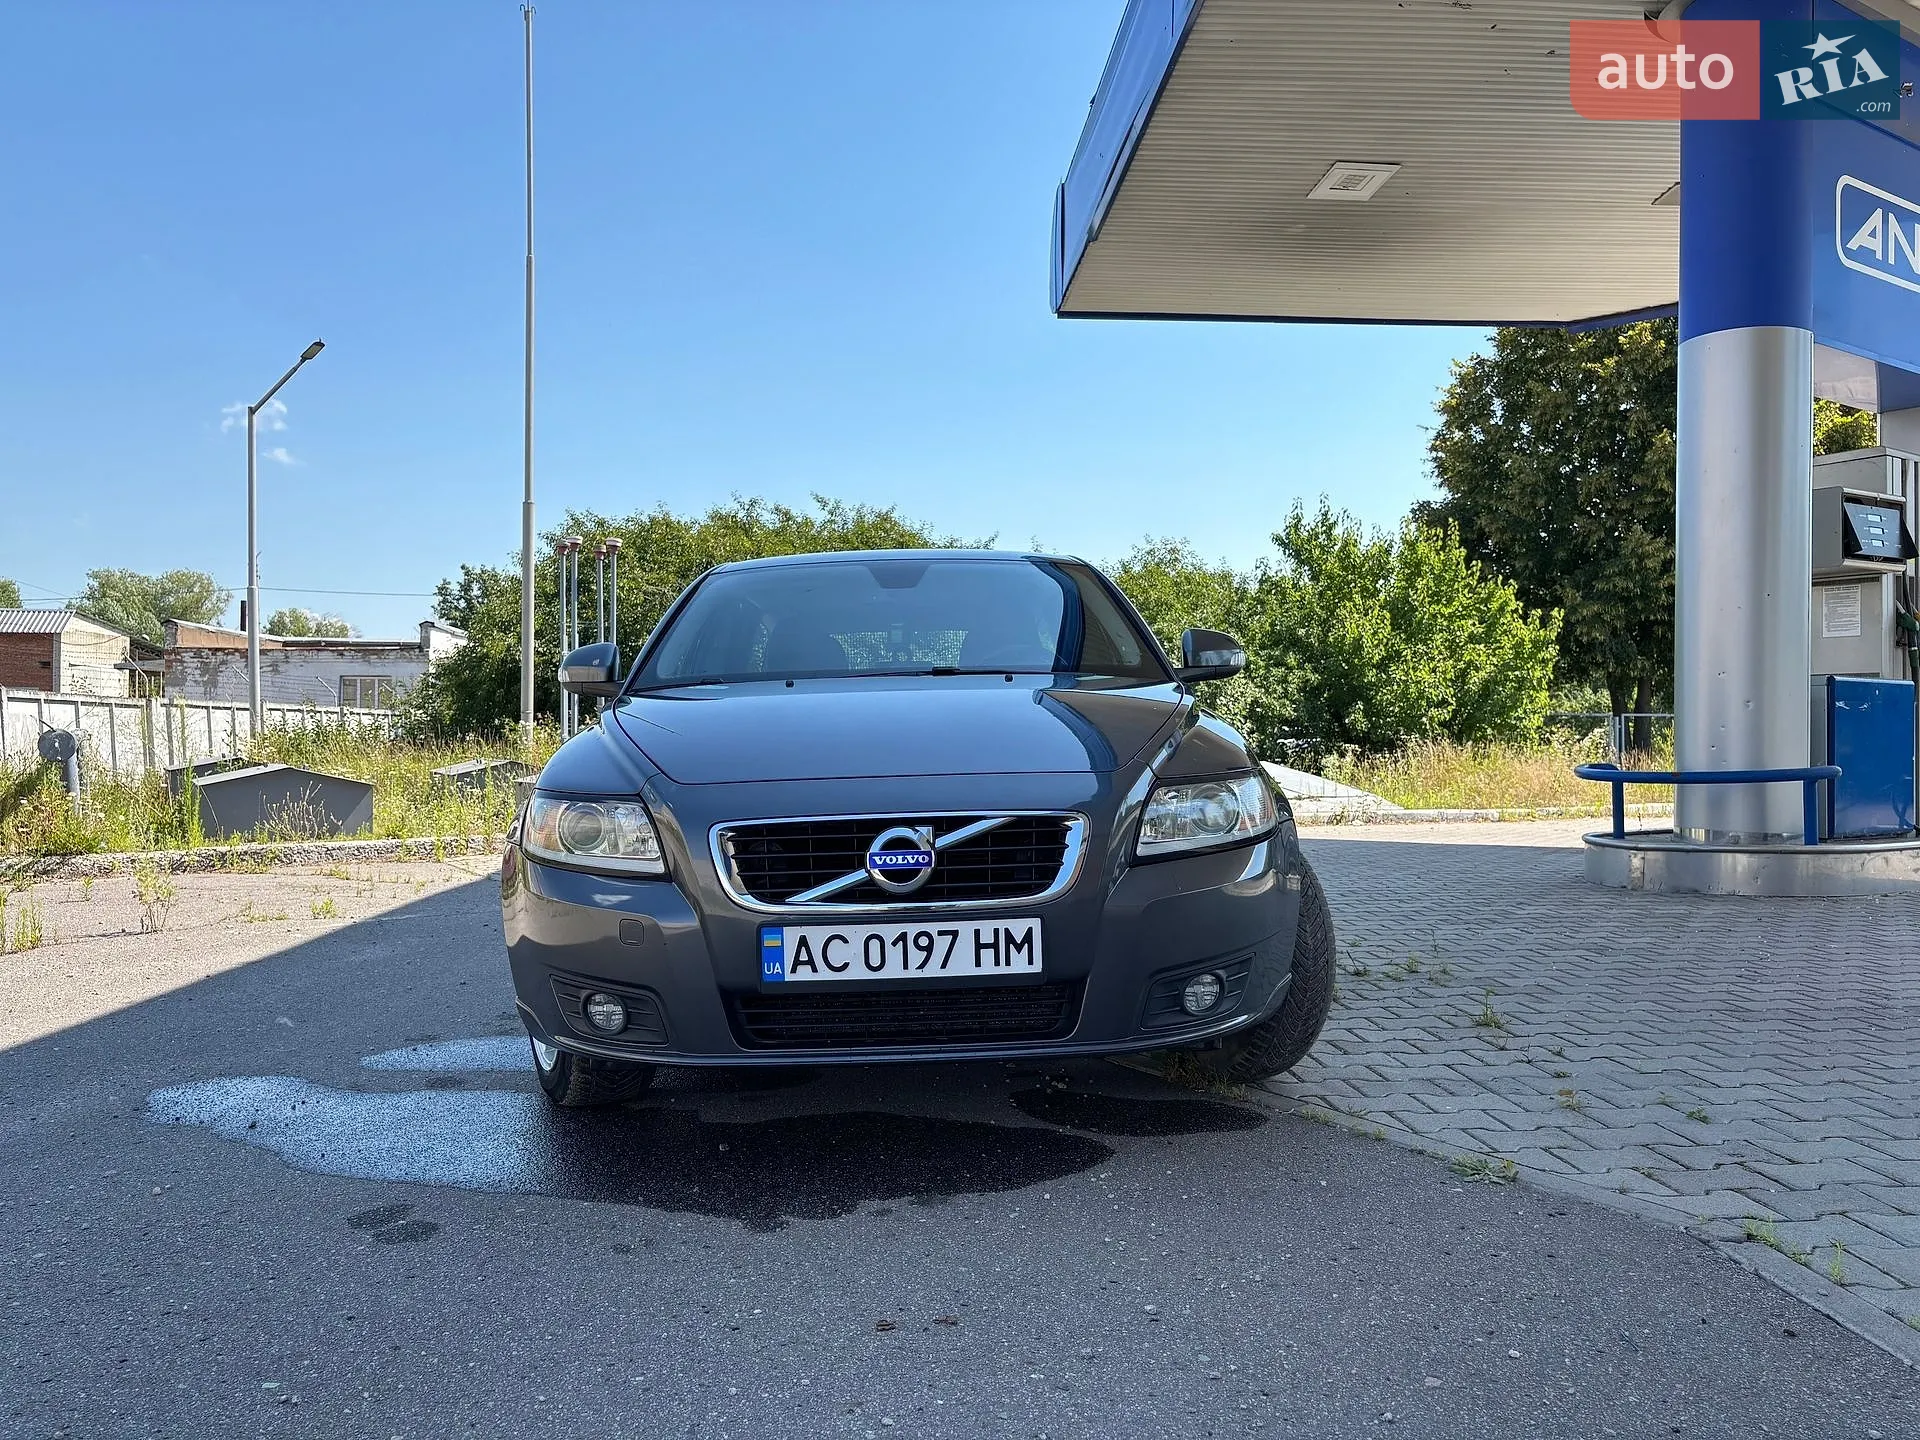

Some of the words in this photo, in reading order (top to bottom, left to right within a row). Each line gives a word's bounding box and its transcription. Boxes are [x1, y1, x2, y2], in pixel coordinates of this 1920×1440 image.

[872, 854, 930, 865] VOLVO
[789, 933, 850, 974] AC
[863, 929, 960, 972] 0197
[973, 926, 1034, 968] HM
[764, 963, 782, 975] UA
